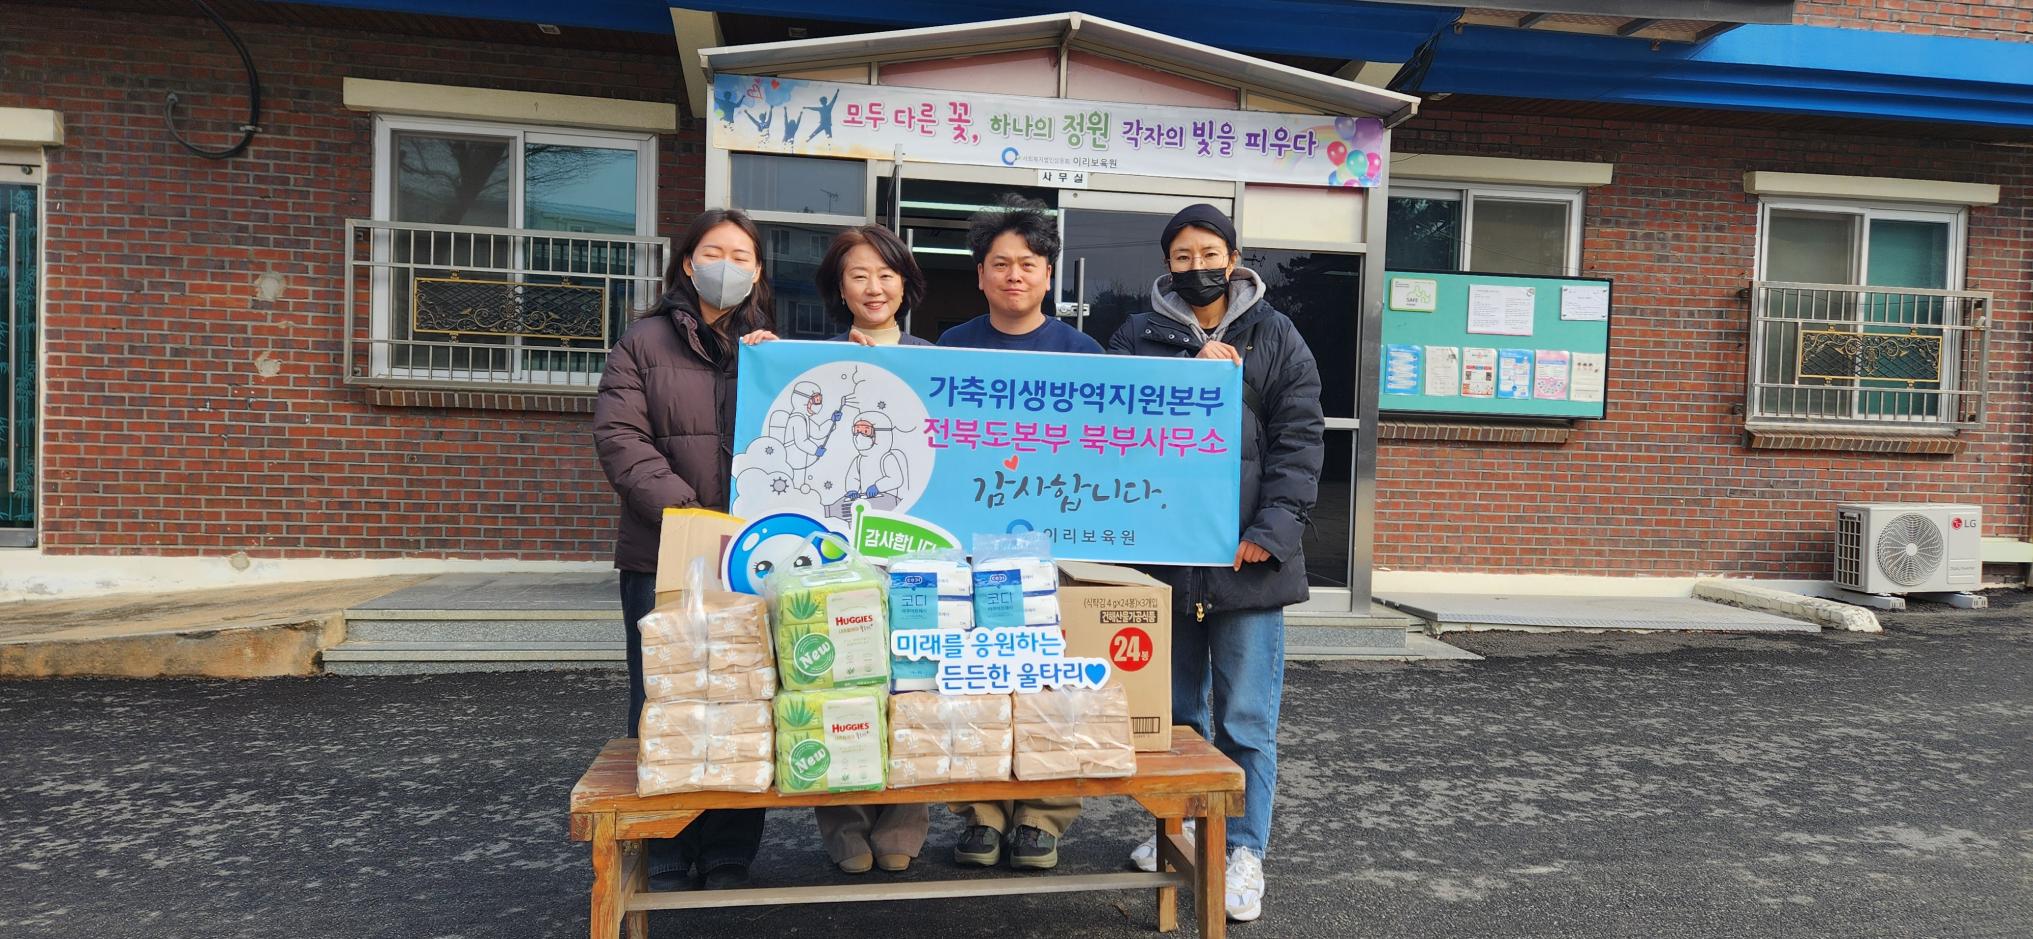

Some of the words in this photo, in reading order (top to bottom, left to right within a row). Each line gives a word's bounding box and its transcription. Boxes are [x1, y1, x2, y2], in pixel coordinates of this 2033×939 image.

[842, 102, 886, 129] 모두
[894, 103, 937, 134] 다른
[948, 101, 980, 144] 꽃,
[989, 113, 1053, 139] 하나의
[1062, 110, 1110, 148] 정원
[1122, 119, 1184, 148] 각자의
[1192, 120, 1236, 155] 빛을
[1245, 126, 1317, 156] 피우다
[1073, 157, 1118, 169] 이리보육원
[929, 375, 1225, 417] 가축위생방역지원본부
[923, 418, 1071, 454] 전북도본부
[1079, 424, 1228, 457] 북부사무소
[973, 470, 1167, 514] 감사합니다.
[1964, 519, 1977, 528] LG
[864, 528, 937, 553] 감사합니다
[1042, 527, 1136, 546] 이리보육원
[901, 594, 927, 607] 코디
[987, 591, 1013, 605] 코디
[835, 614, 873, 626] HUGGIES
[1101, 610, 1157, 623] 건해산물가공식품
[799, 641, 831, 669] New
[897, 633, 965, 659] 미래를
[971, 631, 1062, 658] 응원하는
[941, 663, 1010, 690] 든든한
[1016, 662, 1083, 689] 울타리
[832, 722, 870, 733] HUGGIES
[794, 748, 826, 774] New
